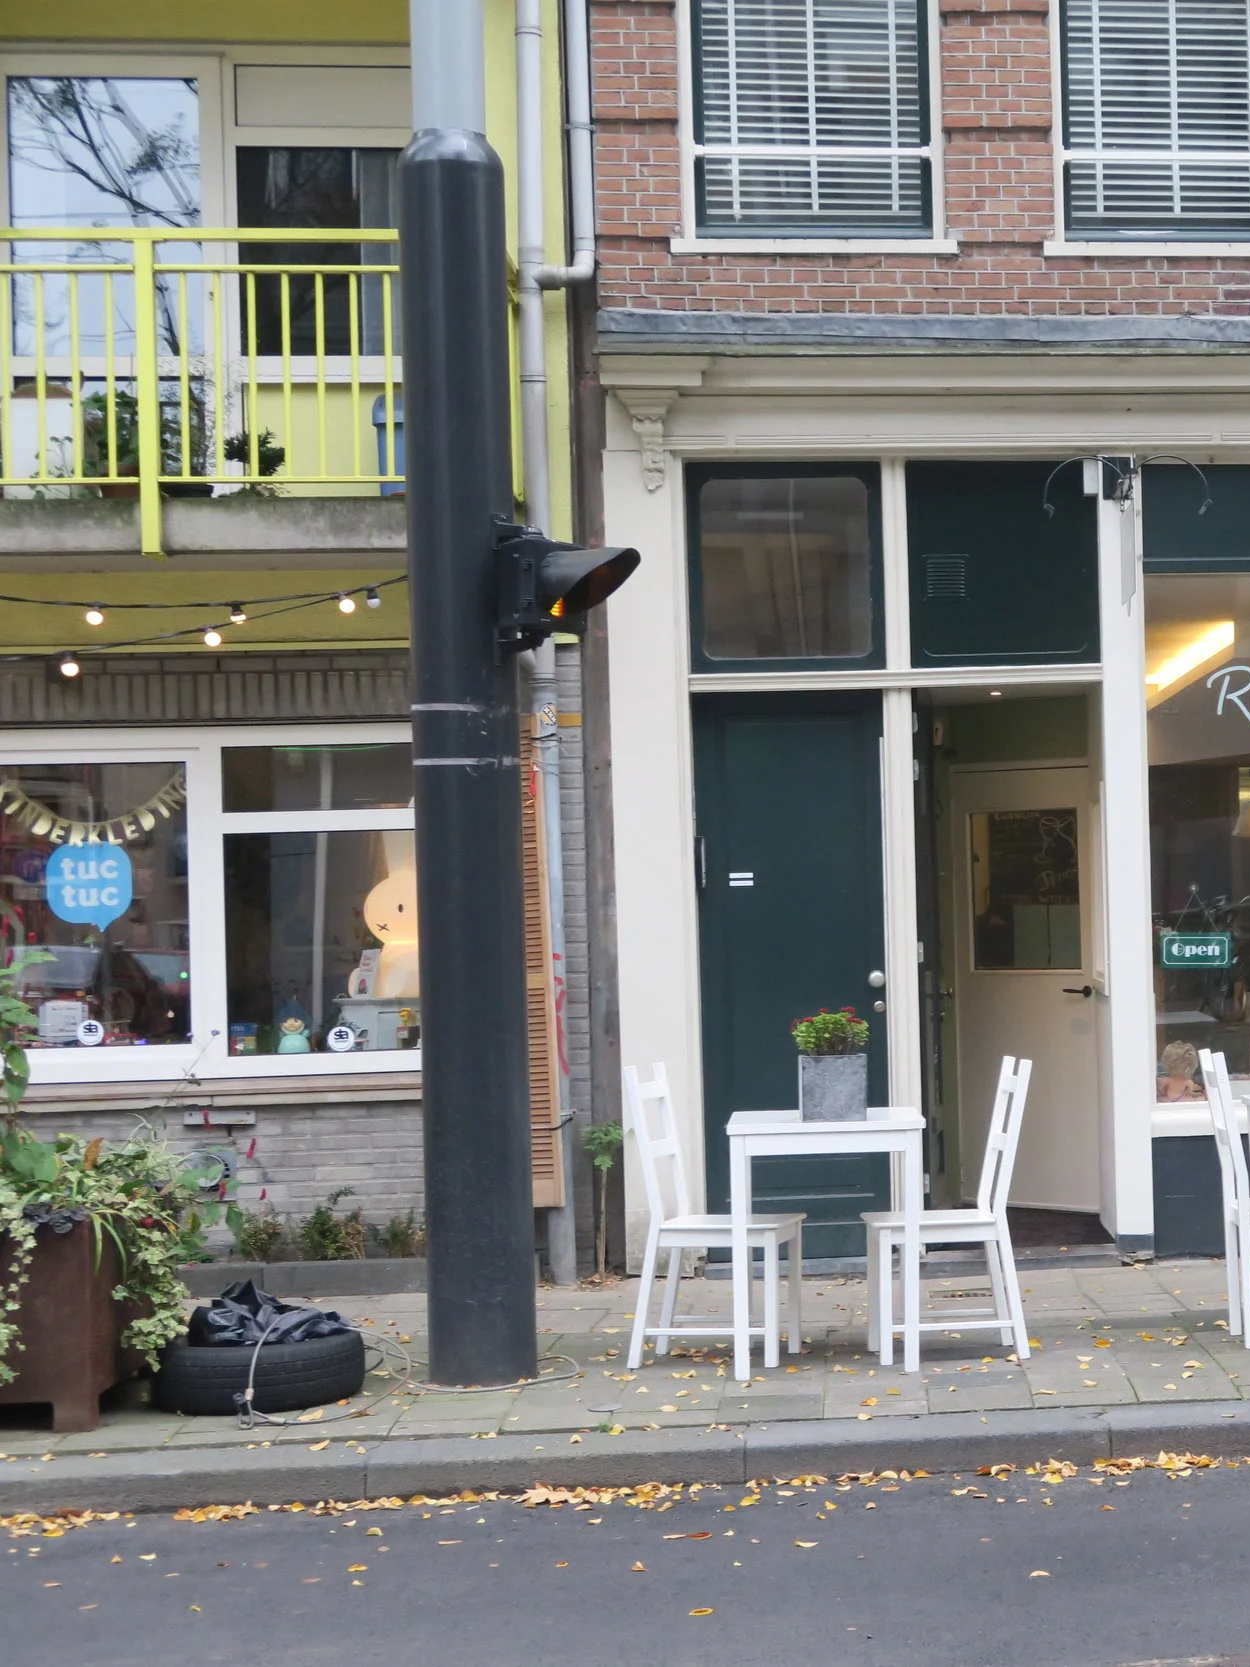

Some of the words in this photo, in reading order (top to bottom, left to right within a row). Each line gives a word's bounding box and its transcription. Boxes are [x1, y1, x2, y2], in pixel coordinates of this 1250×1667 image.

[60, 858, 119, 880] tuc
[61, 885, 119, 907] tuc
[1171, 943, 1220, 957] Open
